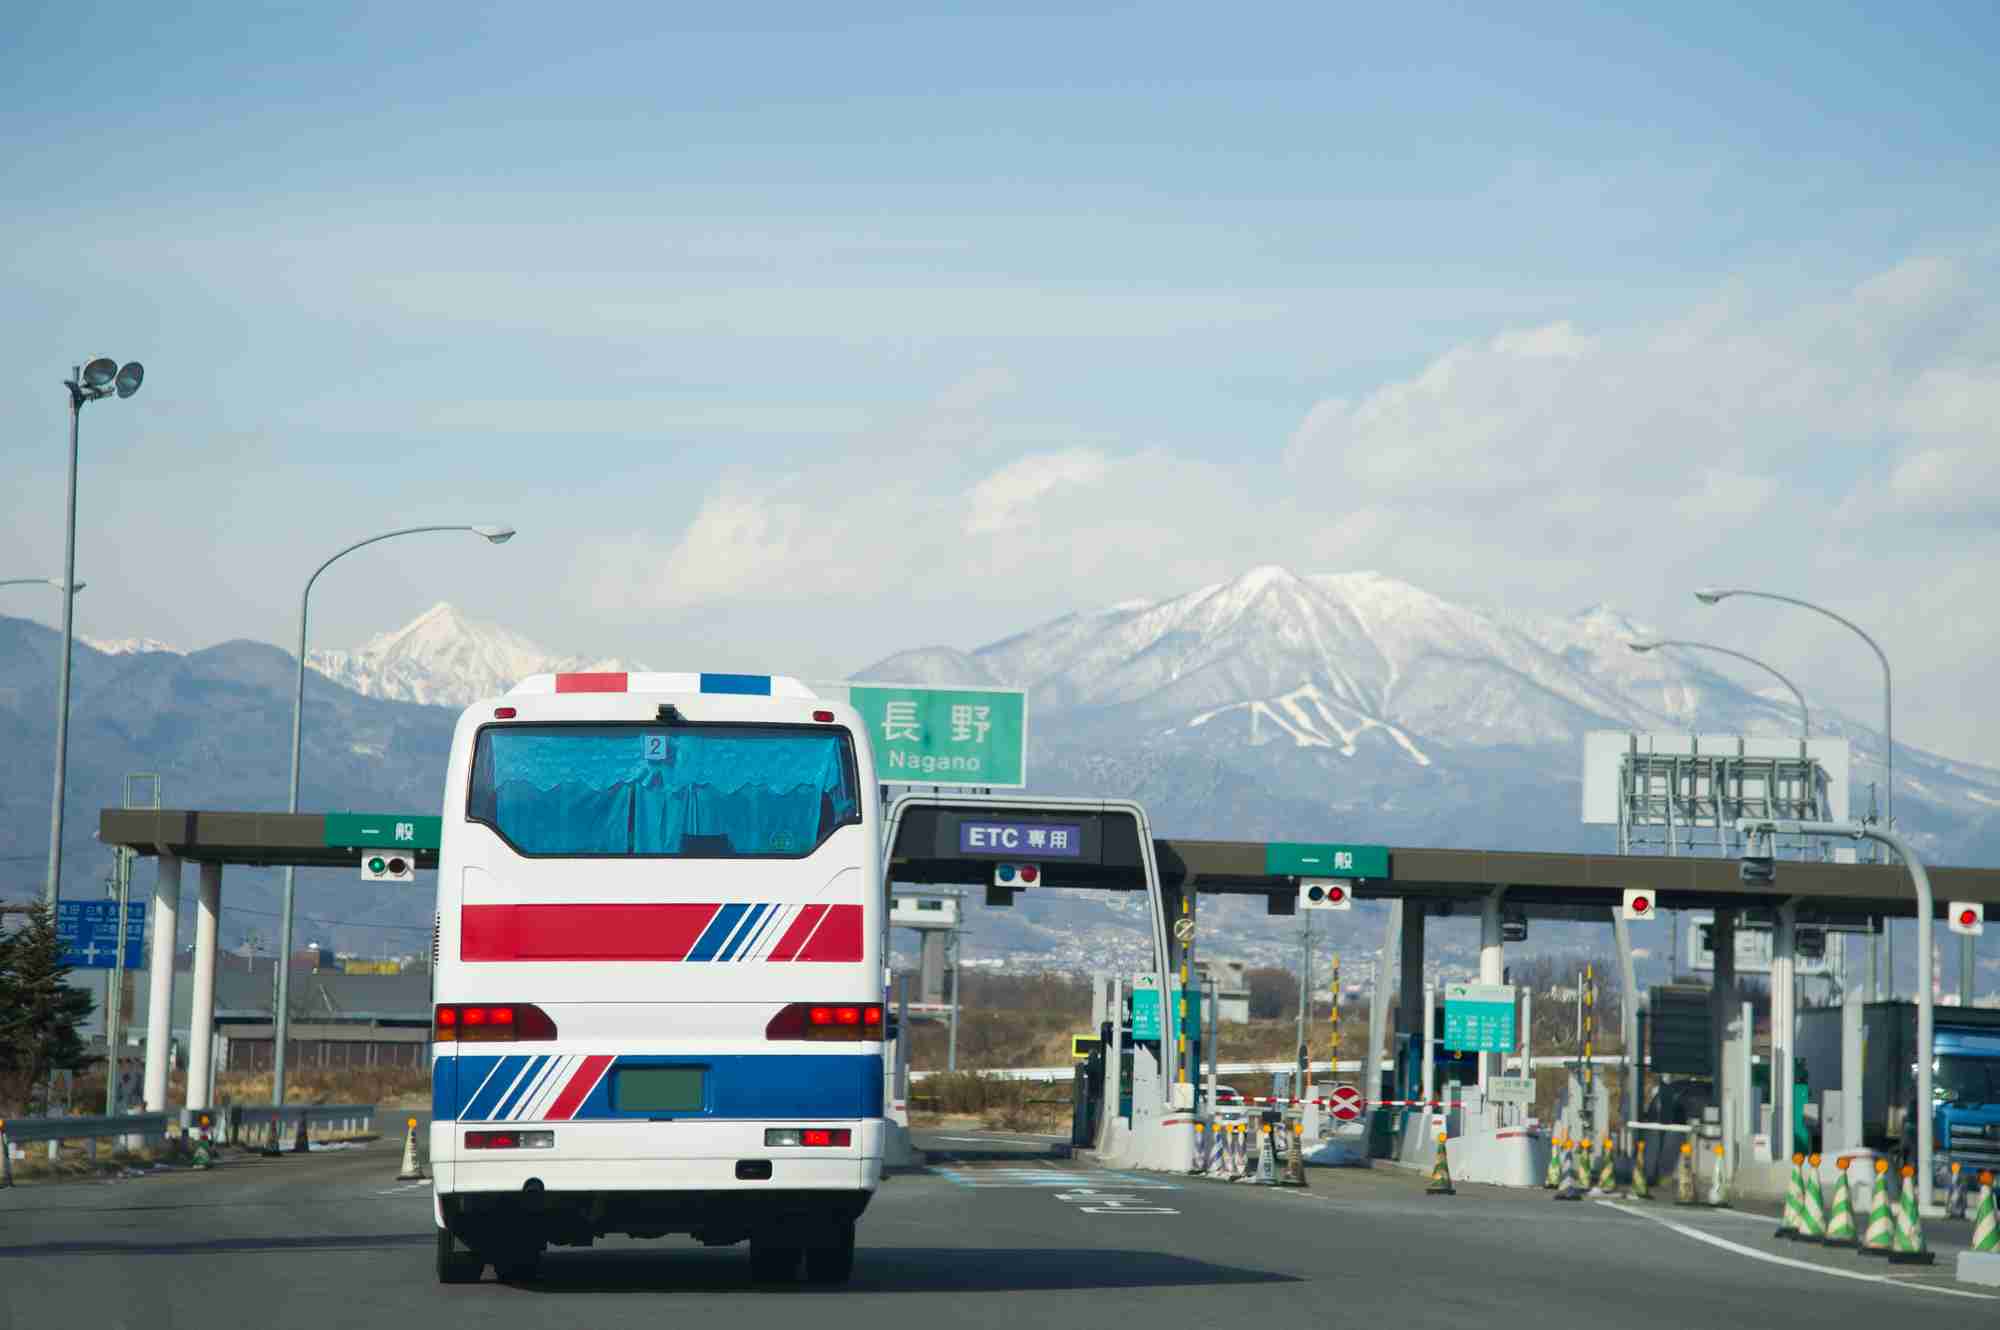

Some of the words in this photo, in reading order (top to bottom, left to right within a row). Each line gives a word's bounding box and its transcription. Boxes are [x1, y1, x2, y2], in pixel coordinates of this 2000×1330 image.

[881, 701, 991, 743] 長野
[650, 738, 662, 756] 2
[889, 749, 981, 773] Nagano
[361, 822, 415, 841] 一般
[969, 827, 1019, 848] ETC
[1027, 829, 1069, 849] 専用
[1301, 851, 1353, 870] 一般
